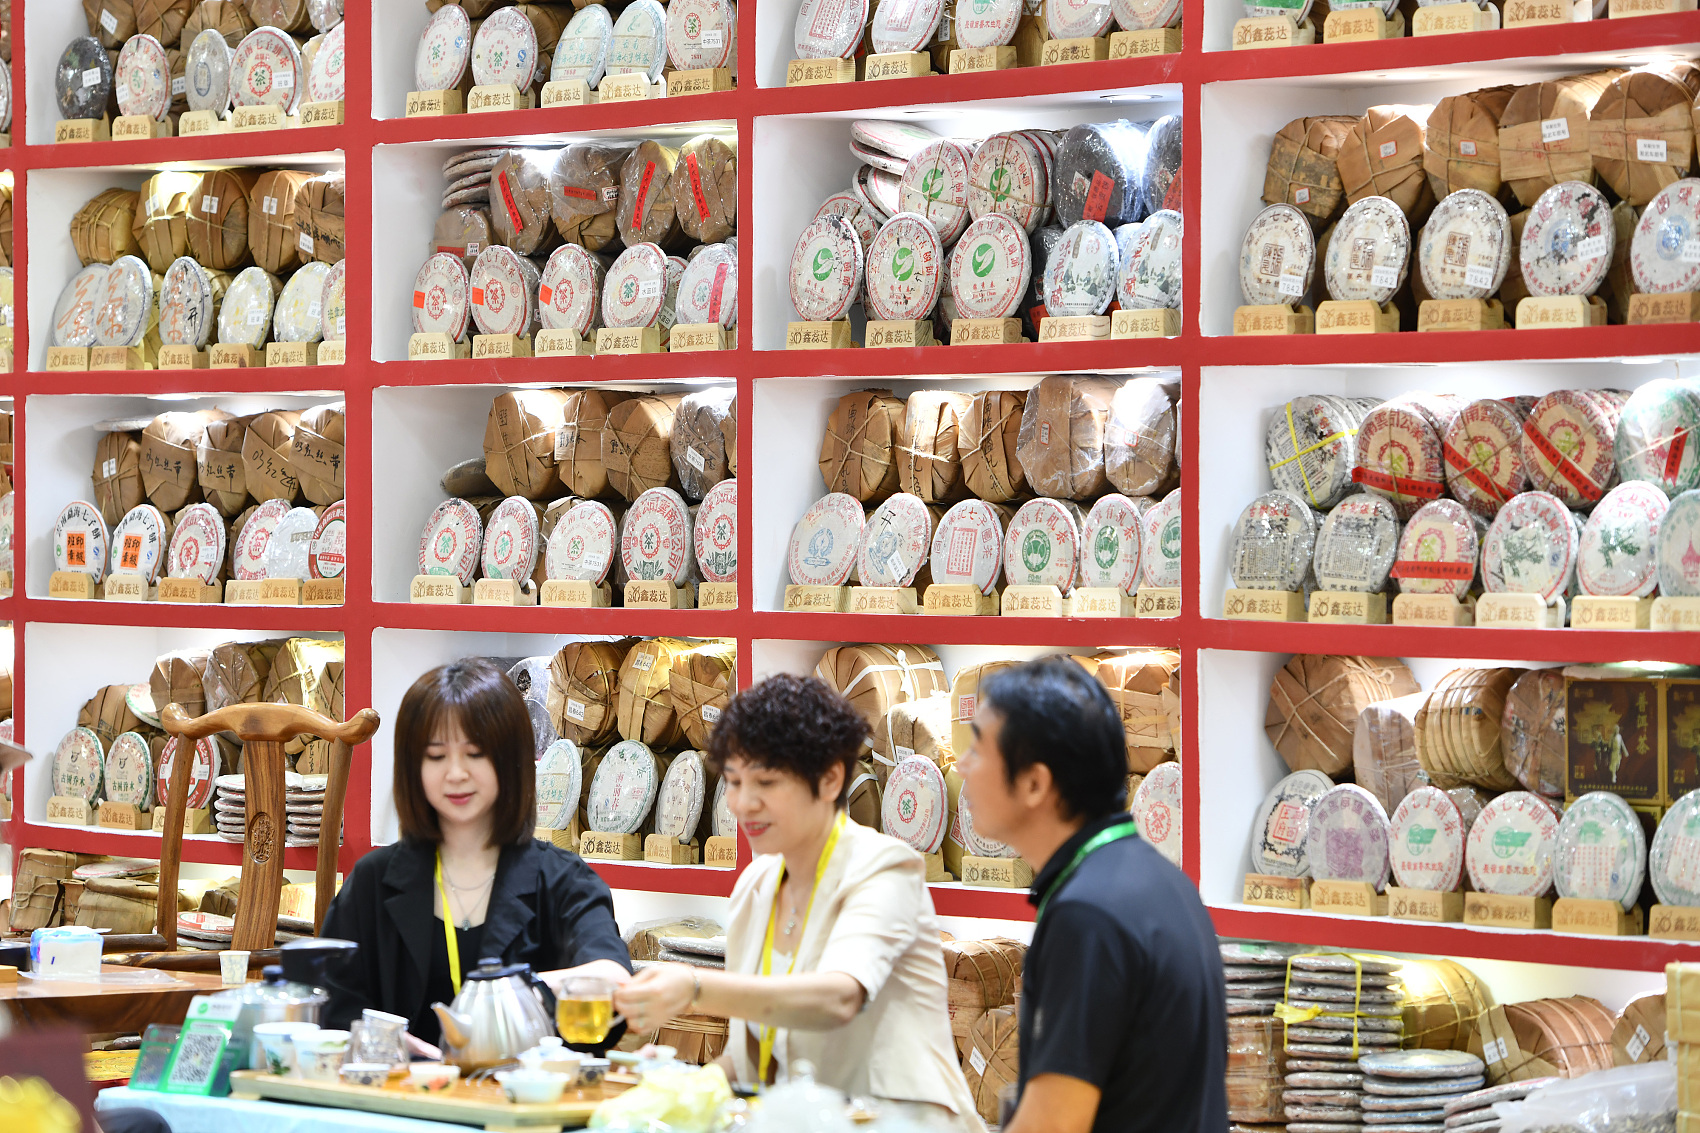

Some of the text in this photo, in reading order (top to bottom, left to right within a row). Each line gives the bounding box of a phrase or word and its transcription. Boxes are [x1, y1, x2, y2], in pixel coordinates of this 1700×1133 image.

[1525, 3, 1561, 21] 鑫蕊达
[1252, 25, 1287, 43] 鑫蕊达
[1342, 17, 1375, 36] 鑫蕊达
[1059, 45, 1090, 62] 鑫蕊达
[1129, 39, 1160, 55] 鑫蕊达
[881, 60, 908, 77] 鑫蕊达
[966, 54, 994, 70] 鑫蕊达
[804, 65, 833, 82] 鑫蕊达
[613, 83, 641, 98] 鑫蕊达
[683, 77, 711, 92] 鑫蕊达
[482, 92, 511, 107] 鑫蕊达
[554, 88, 581, 103] 鑫蕊达
[419, 98, 442, 113] 鑫蕊达
[247, 112, 278, 127] 鑫蕊达
[312, 107, 335, 122] 鑫蕊达
[68, 126, 90, 139] 鑫蕊达
[126, 123, 148, 136] 鑫蕊达
[1375, 276, 1394, 287] 7842
[1470, 275, 1489, 286] 7842
[1282, 283, 1300, 294] 7842
[1335, 311, 1370, 328] 鑫蕊达
[1443, 306, 1476, 324] 鑫蕊达
[1543, 306, 1579, 325] 鑫蕊达
[1057, 322, 1087, 338] 鑫蕊达
[1129, 318, 1160, 334] 鑫蕊达
[1251, 315, 1285, 332] 鑫蕊达
[686, 333, 715, 347] 鑫蕊达
[803, 330, 829, 344] 鑫蕊达
[884, 329, 912, 344] 鑫蕊达
[971, 326, 1000, 341] 鑫蕊达
[421, 341, 447, 354] 鑫蕊达
[485, 341, 510, 354] 鑫蕊达
[548, 339, 574, 352] 鑫蕊达
[613, 336, 639, 349] 鑫蕊达
[170, 353, 190, 366] 鑫蕊达
[282, 351, 304, 364] 鑫蕊达
[117, 583, 140, 596] 鑫蕊达
[172, 586, 196, 599] 鑫蕊达
[269, 584, 296, 598] 鑫蕊达
[315, 586, 343, 600] 鑫蕊达
[425, 585, 454, 597] 鑫蕊达
[487, 588, 510, 602] 鑫蕊达
[559, 589, 588, 603] 鑫蕊达
[640, 588, 668, 602] 鑫蕊达
[804, 593, 833, 609] 鑫蕊达
[867, 596, 895, 610] 鑫蕊达
[942, 593, 972, 609] 鑫蕊达
[1021, 593, 1053, 609] 鑫蕊达
[1090, 596, 1116, 613] 鑫蕊达
[1247, 598, 1283, 616] 鑫蕊达
[1330, 600, 1364, 618] 鑫蕊达
[59, 806, 83, 819] 鑫蕊达
[112, 812, 133, 826] 鑫蕊达
[597, 841, 621, 854] 鑫蕊达
[654, 844, 670, 858] 鑫蕊达
[717, 846, 736, 860] 鑫蕊
[981, 868, 1010, 883] 鑫蕊达
[1264, 886, 1296, 903] 鑫蕊达
[1330, 890, 1366, 908] 鑫蕊达
[1408, 902, 1440, 918] 鑫蕊达
[1674, 915, 1700, 932] 鑫蕊
